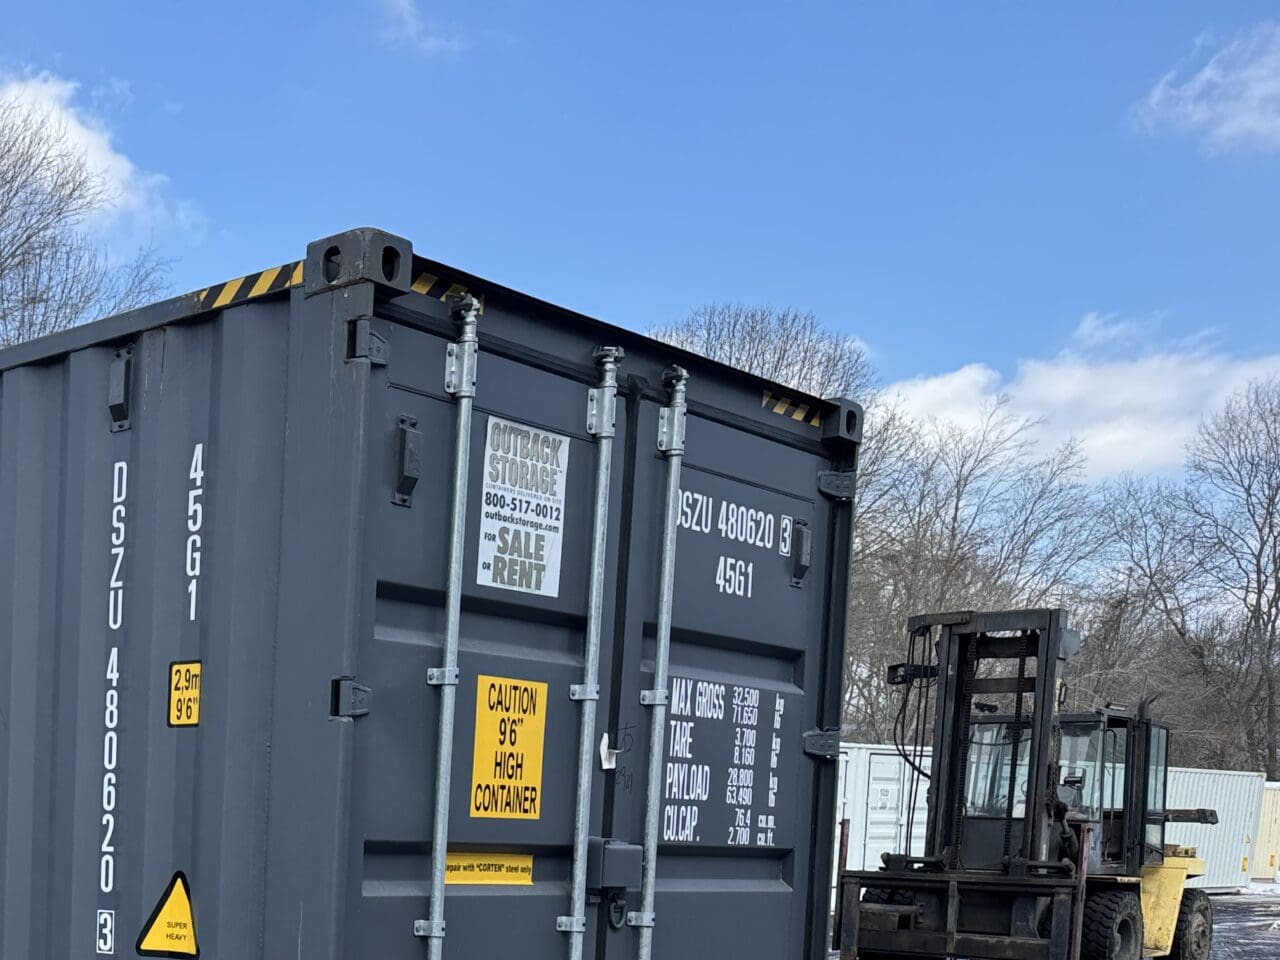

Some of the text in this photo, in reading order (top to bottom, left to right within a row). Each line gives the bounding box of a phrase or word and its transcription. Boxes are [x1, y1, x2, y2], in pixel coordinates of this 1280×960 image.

[489, 422, 563, 468] OUTBACK
[485, 492, 561, 521] 800-517-0012
[485, 510, 559, 533] outbackstorage.com
[185, 443, 204, 621] 45G1
[484, 526, 545, 562] FOR SALE
[718, 501, 774, 549] 480620
[780, 517, 792, 554] 3
[482, 555, 546, 591] OR RENT
[715, 556, 753, 598] 45G1
[97, 461, 127, 952] DSZU 480620 3
[488, 683, 537, 716] CAUTION
[670, 678, 693, 716] MAX
[695, 681, 726, 720] GROSS
[775, 693, 784, 714] kg
[669, 720, 694, 758] TARE
[772, 732, 781, 754] kg
[494, 751, 524, 780] HIGH
[665, 763, 710, 801] PAYLOAD
[769, 771, 778, 793] kg
[474, 784, 537, 814] CONTAINER
[734, 808, 751, 827] 76.4
[463, 863, 475, 872] with
[506, 865, 519, 873] steel
[520, 865, 531, 875] only
[166, 921, 187, 929] SUPER
[166, 933, 187, 941] HEAVY
